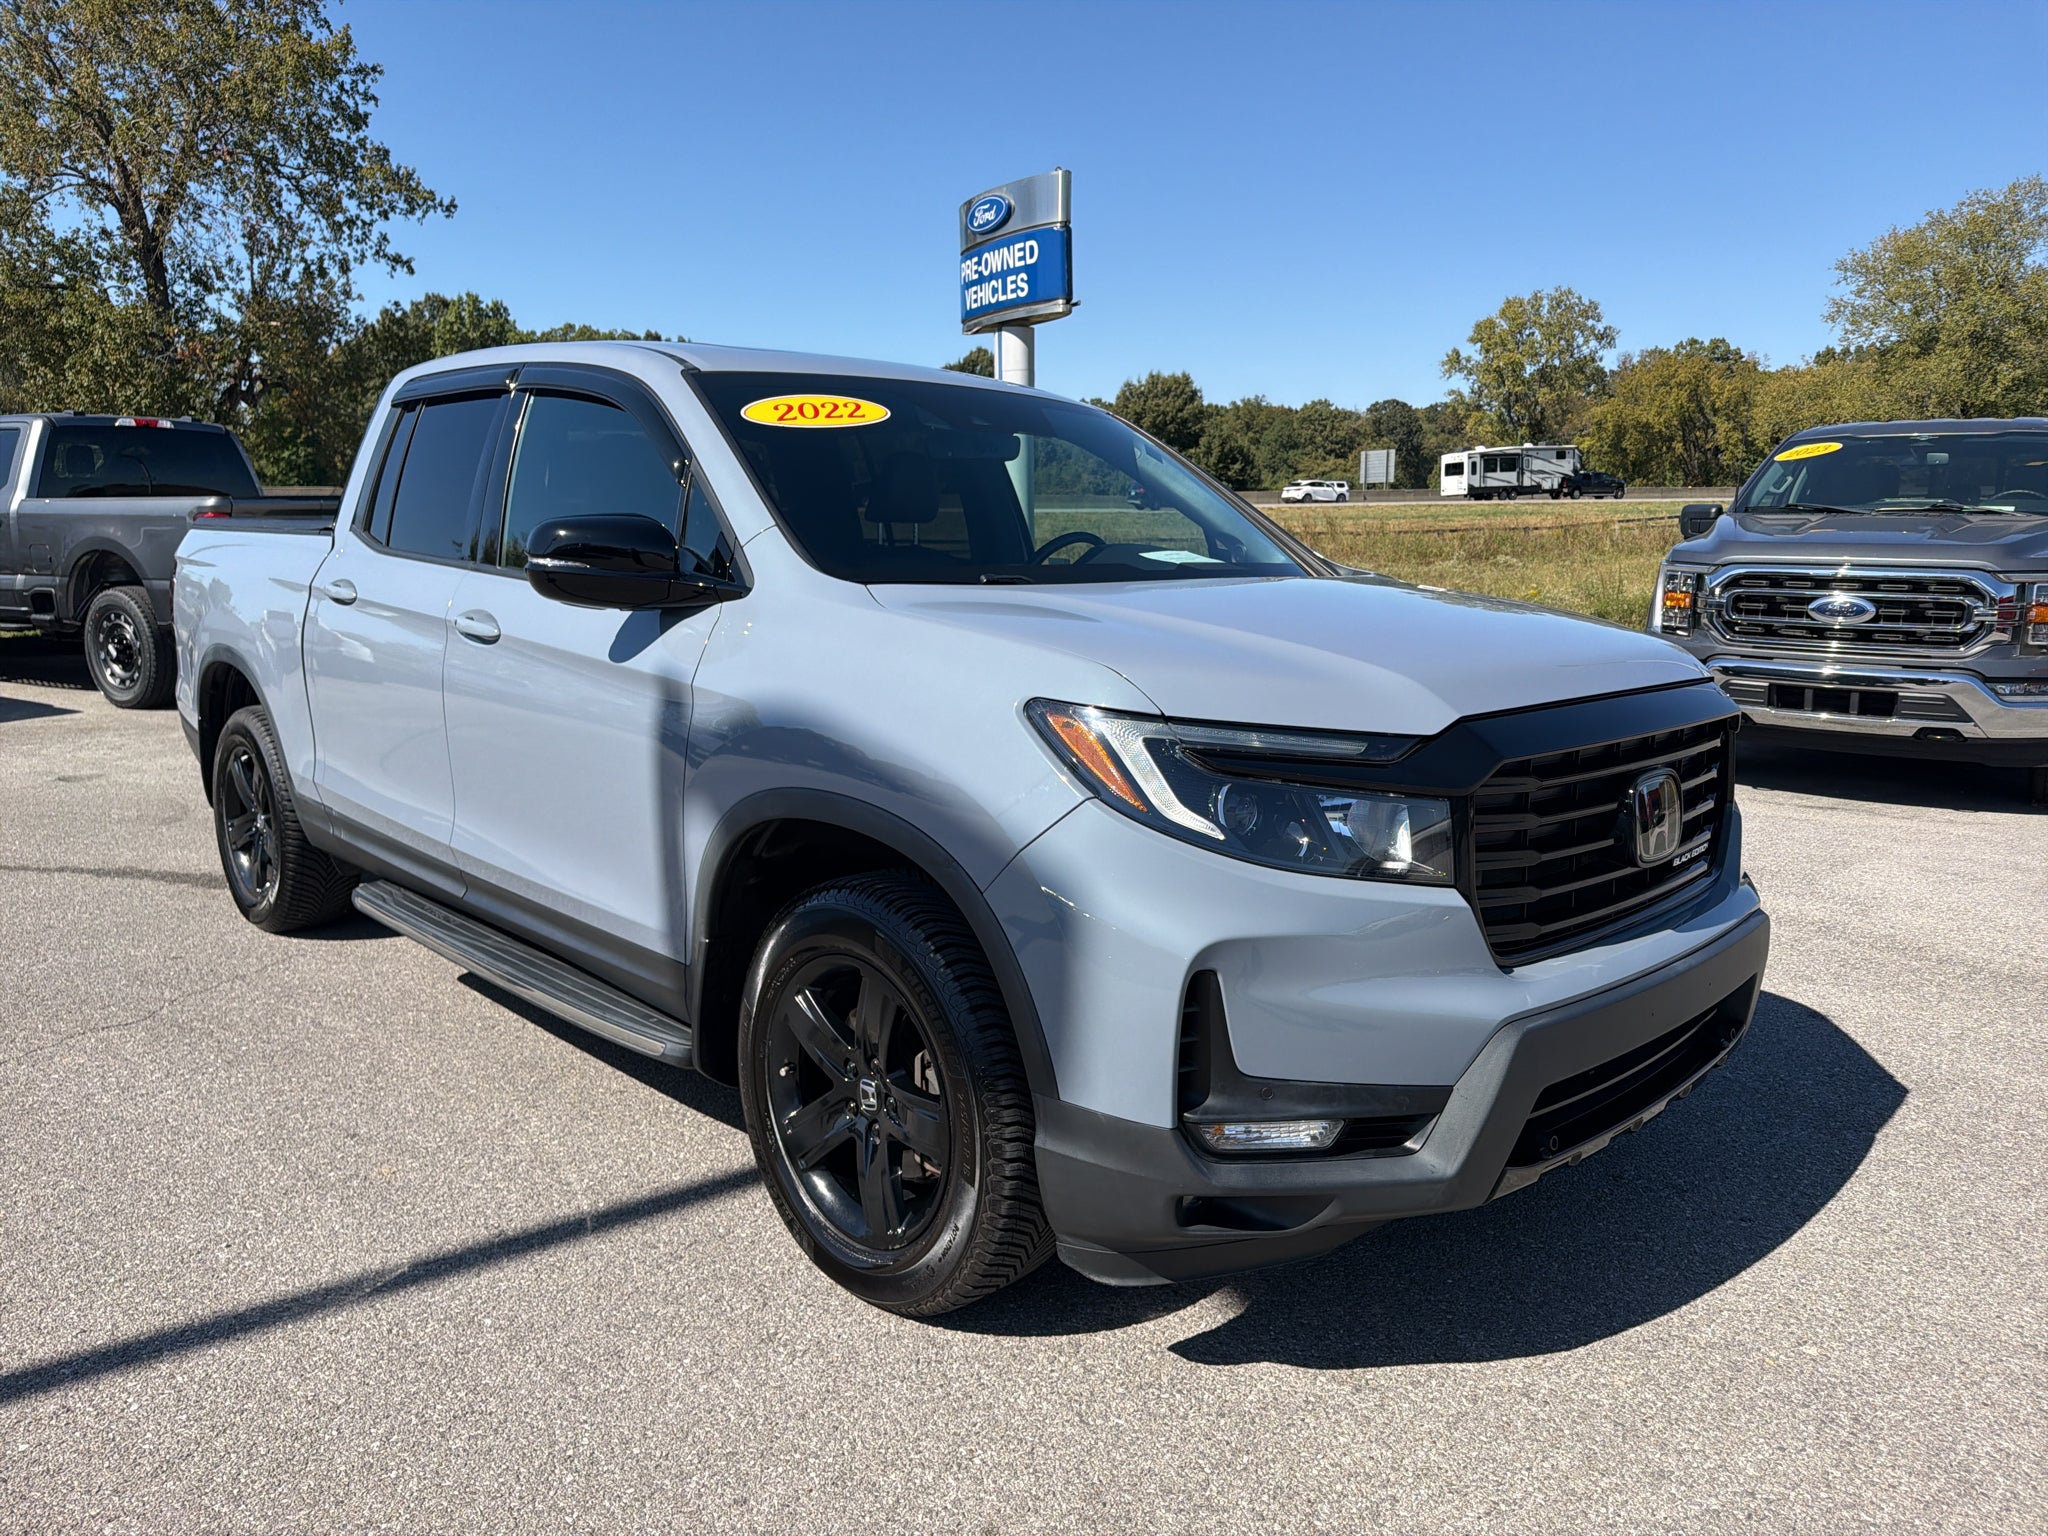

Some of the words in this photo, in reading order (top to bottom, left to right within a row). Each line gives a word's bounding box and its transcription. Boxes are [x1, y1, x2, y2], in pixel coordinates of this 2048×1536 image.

[973, 203, 997, 227] Ford
[961, 239, 1039, 285] PRE-OWNED
[965, 272, 1029, 311] VEHICLES
[773, 401, 866, 422] 2022
[1672, 851, 1691, 867] BLACK
